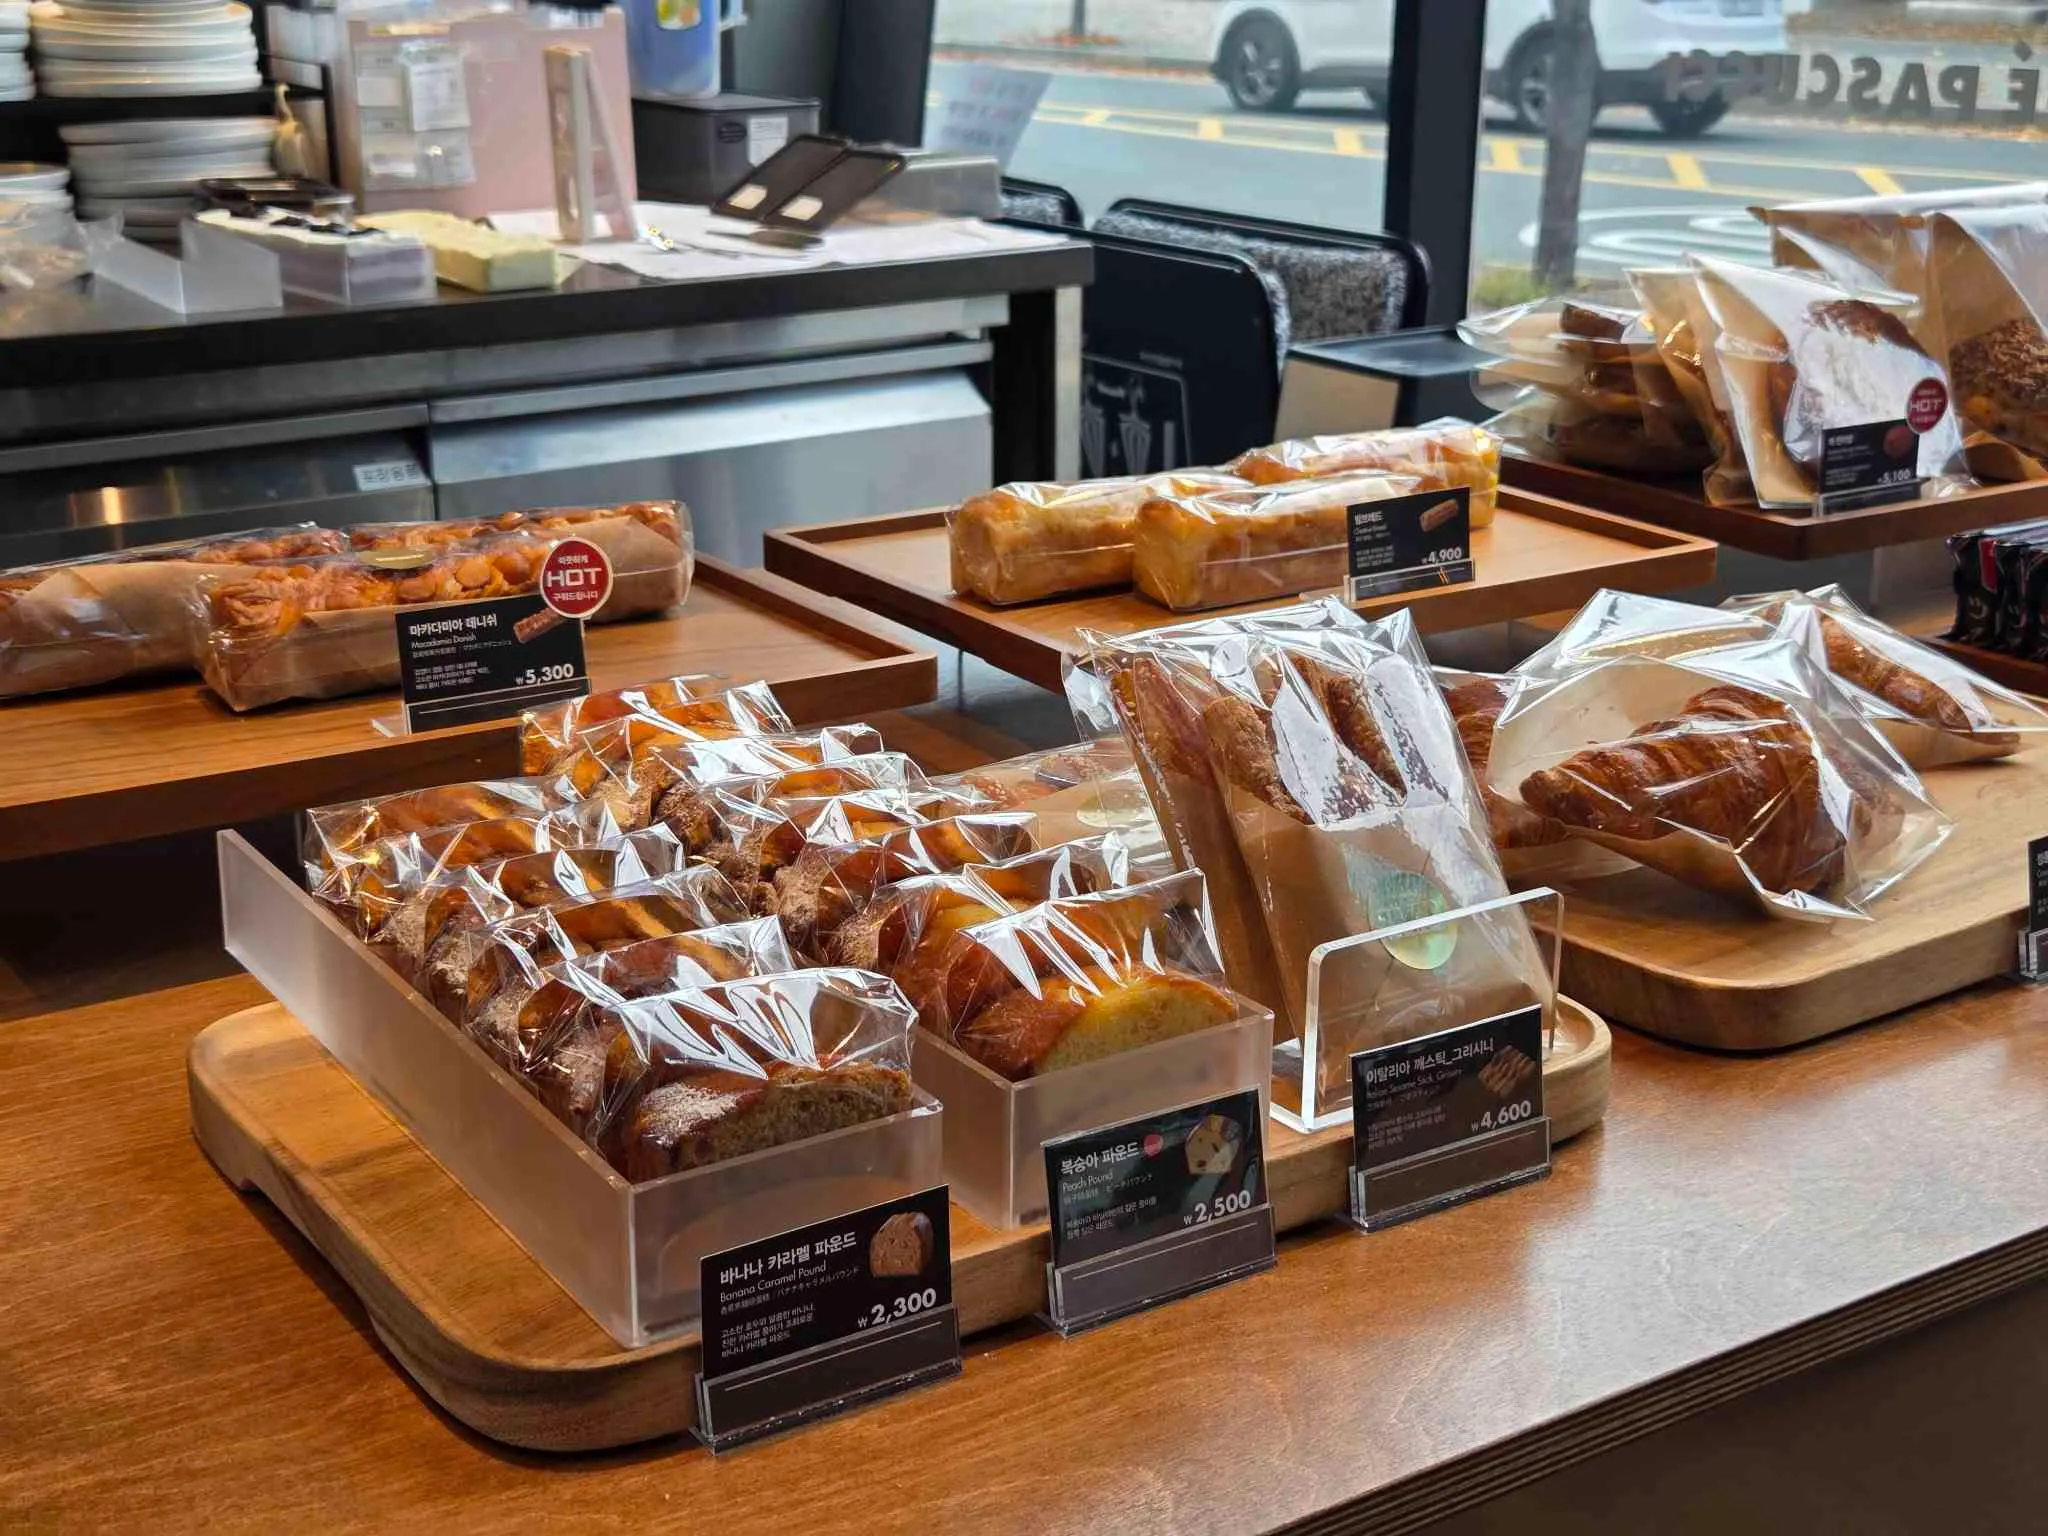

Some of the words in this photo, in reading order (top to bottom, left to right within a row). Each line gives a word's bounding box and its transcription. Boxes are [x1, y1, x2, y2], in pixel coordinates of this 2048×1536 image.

[1909, 399, 1942, 412] HOT
[547, 567, 602, 588] HOT
[409, 618, 464, 637] 마카다미아
[465, 613, 498, 630] 데니쉬
[410, 637, 453, 649] Macadamia
[453, 632, 477, 644] Danish
[515, 663, 574, 686] ₩5,300
[1366, 1060, 1411, 1084] 이탈리아
[1414, 1037, 1495, 1070] 깨스틱_그리시니
[1470, 1100, 1532, 1132] ₩4,600
[1060, 1151, 1100, 1175] 복숭아
[1101, 1141, 1140, 1164] 파운드
[1062, 1176, 1087, 1194] Peach
[1088, 1168, 1113, 1186] Pound
[1183, 1189, 1251, 1226] ₩2,500
[720, 1258, 764, 1285] 바나나
[767, 1243, 811, 1270] 카라멜
[814, 1231, 857, 1256] 파운드
[720, 1285, 756, 1303] Banana
[757, 1268, 797, 1291] Caramel
[798, 1258, 827, 1280] Pound
[857, 1287, 937, 1328] ₩2,300
